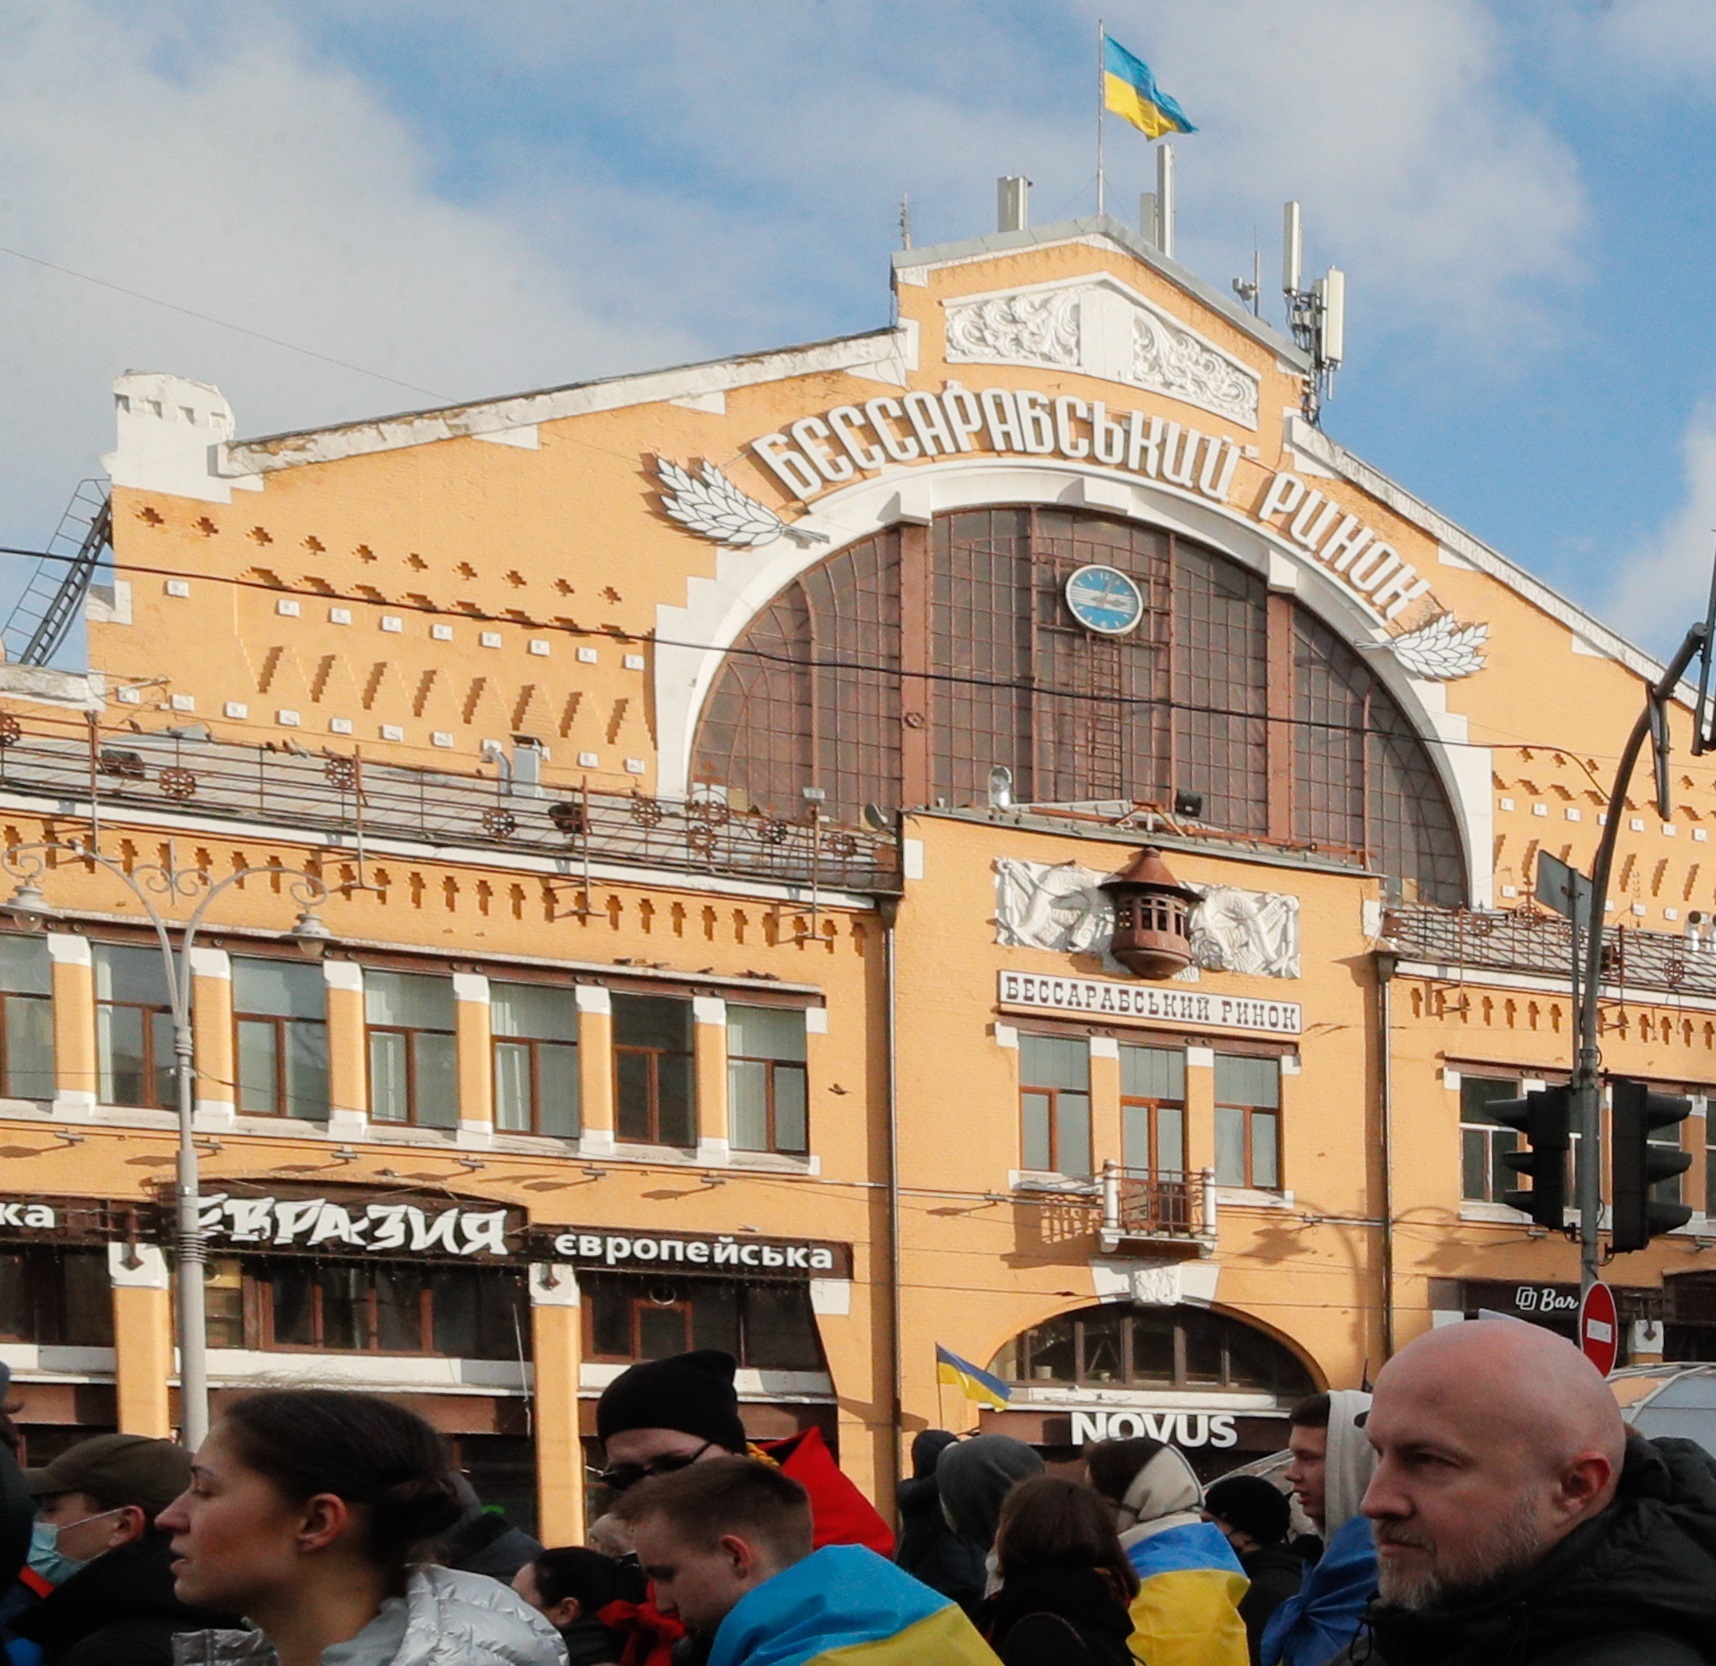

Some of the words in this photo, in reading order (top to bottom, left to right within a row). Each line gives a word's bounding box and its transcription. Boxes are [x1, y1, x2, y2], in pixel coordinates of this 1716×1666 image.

[751, 387, 1242, 501] БЕССАРАБСЬКИЙ
[1257, 471, 1433, 621] РИНОК
[1005, 976, 1210, 1021] БЕССАРАБСЬКИЙ
[1221, 999, 1297, 1030] РИНОК
[555, 1231, 834, 1271] європейська
[1539, 1287, 1580, 1311] Bar
[1071, 1411, 1238, 1448] NOVUS
